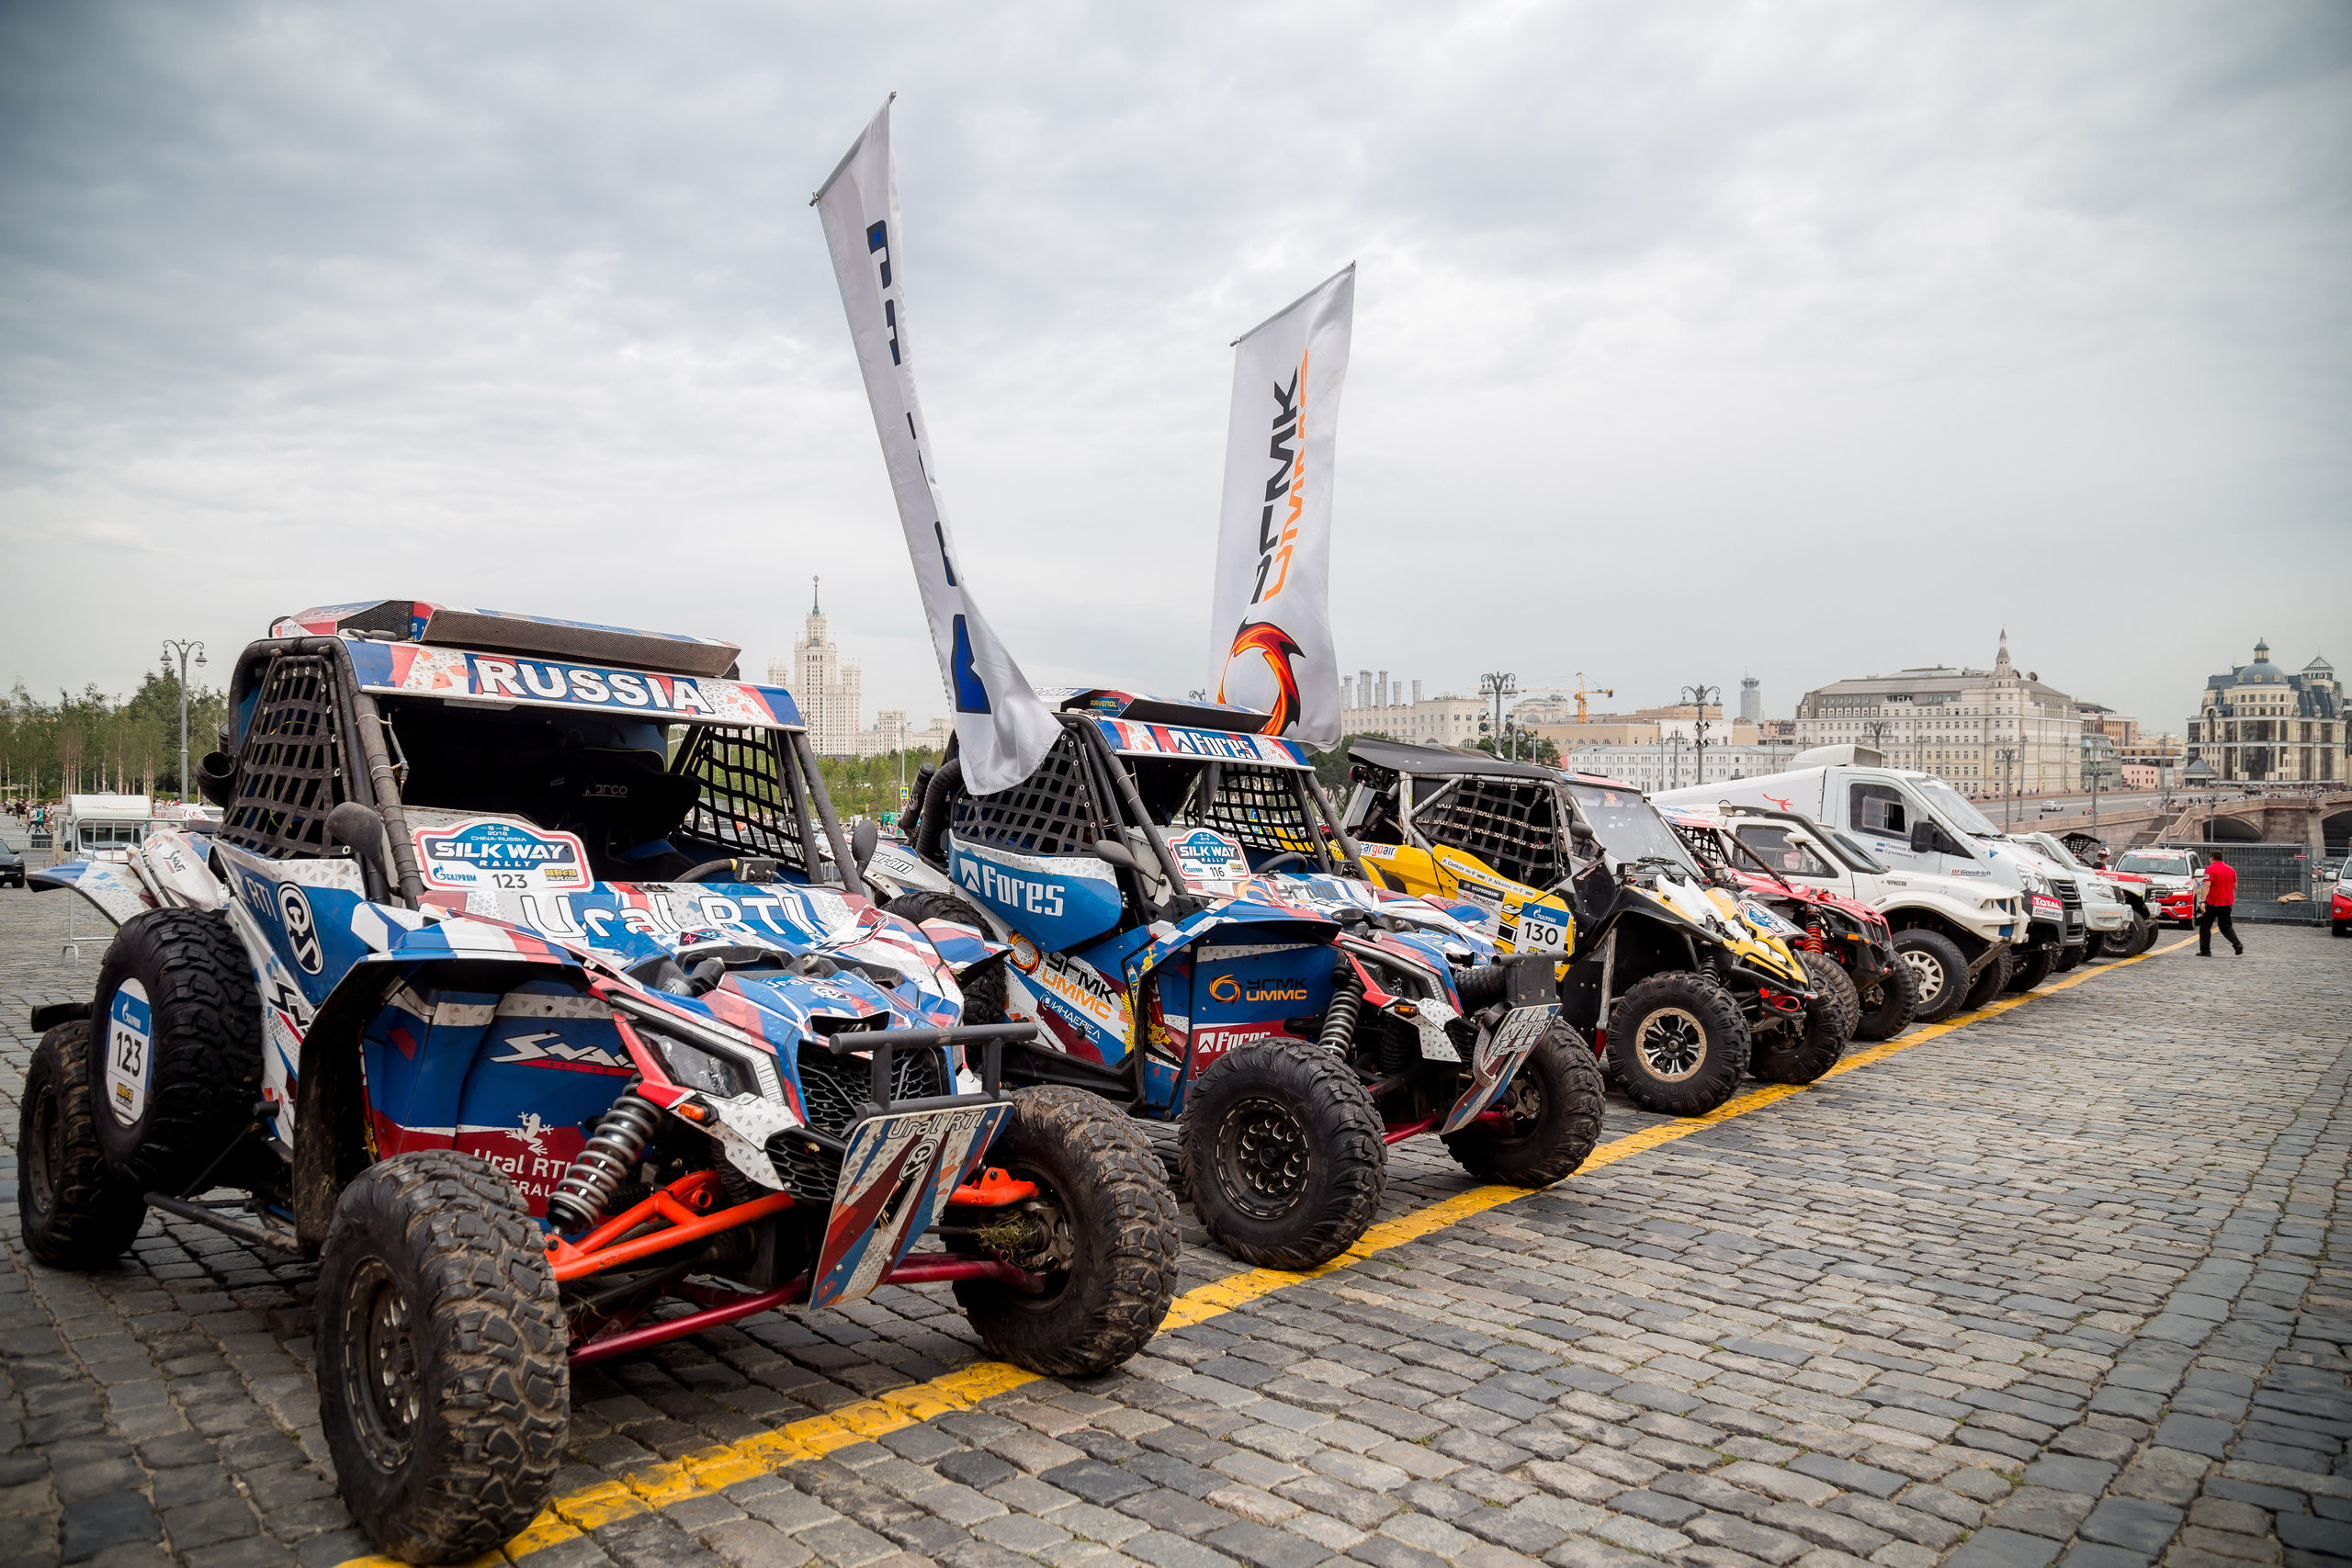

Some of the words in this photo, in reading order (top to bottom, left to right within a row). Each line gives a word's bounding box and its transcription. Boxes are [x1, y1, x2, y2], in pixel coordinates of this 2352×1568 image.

[472, 658, 715, 714] RUSSIA
[1090, 699, 1117, 707] RAVENOL
[1193, 731, 1260, 761] Fores
[435, 841, 503, 859] SILK
[506, 843, 566, 860] WAY
[1179, 845, 1211, 857] SILK
[1210, 846, 1236, 858] WAY
[870, 852, 915, 875] an-am
[1209, 866, 1225, 877] 116
[1951, 868, 1992, 876] BFGoodrich
[492, 874, 527, 889] 123
[982, 864, 1066, 917] Fores
[2033, 897, 2062, 909] TOTAL
[520, 894, 678, 940] Ural
[698, 896, 818, 937] RTI
[1524, 921, 1559, 945] 130
[1046, 953, 1117, 1005] УГМК
[1246, 977, 1306, 990] УГМК
[1042, 967, 1112, 1020] UMMC
[1246, 989, 1307, 1001] UMMC
[116, 1031, 142, 1077] 123
[548, 1061, 609, 1074] RACING
[887, 1113, 944, 1140] Ural
[944, 1109, 989, 1134] RTI
